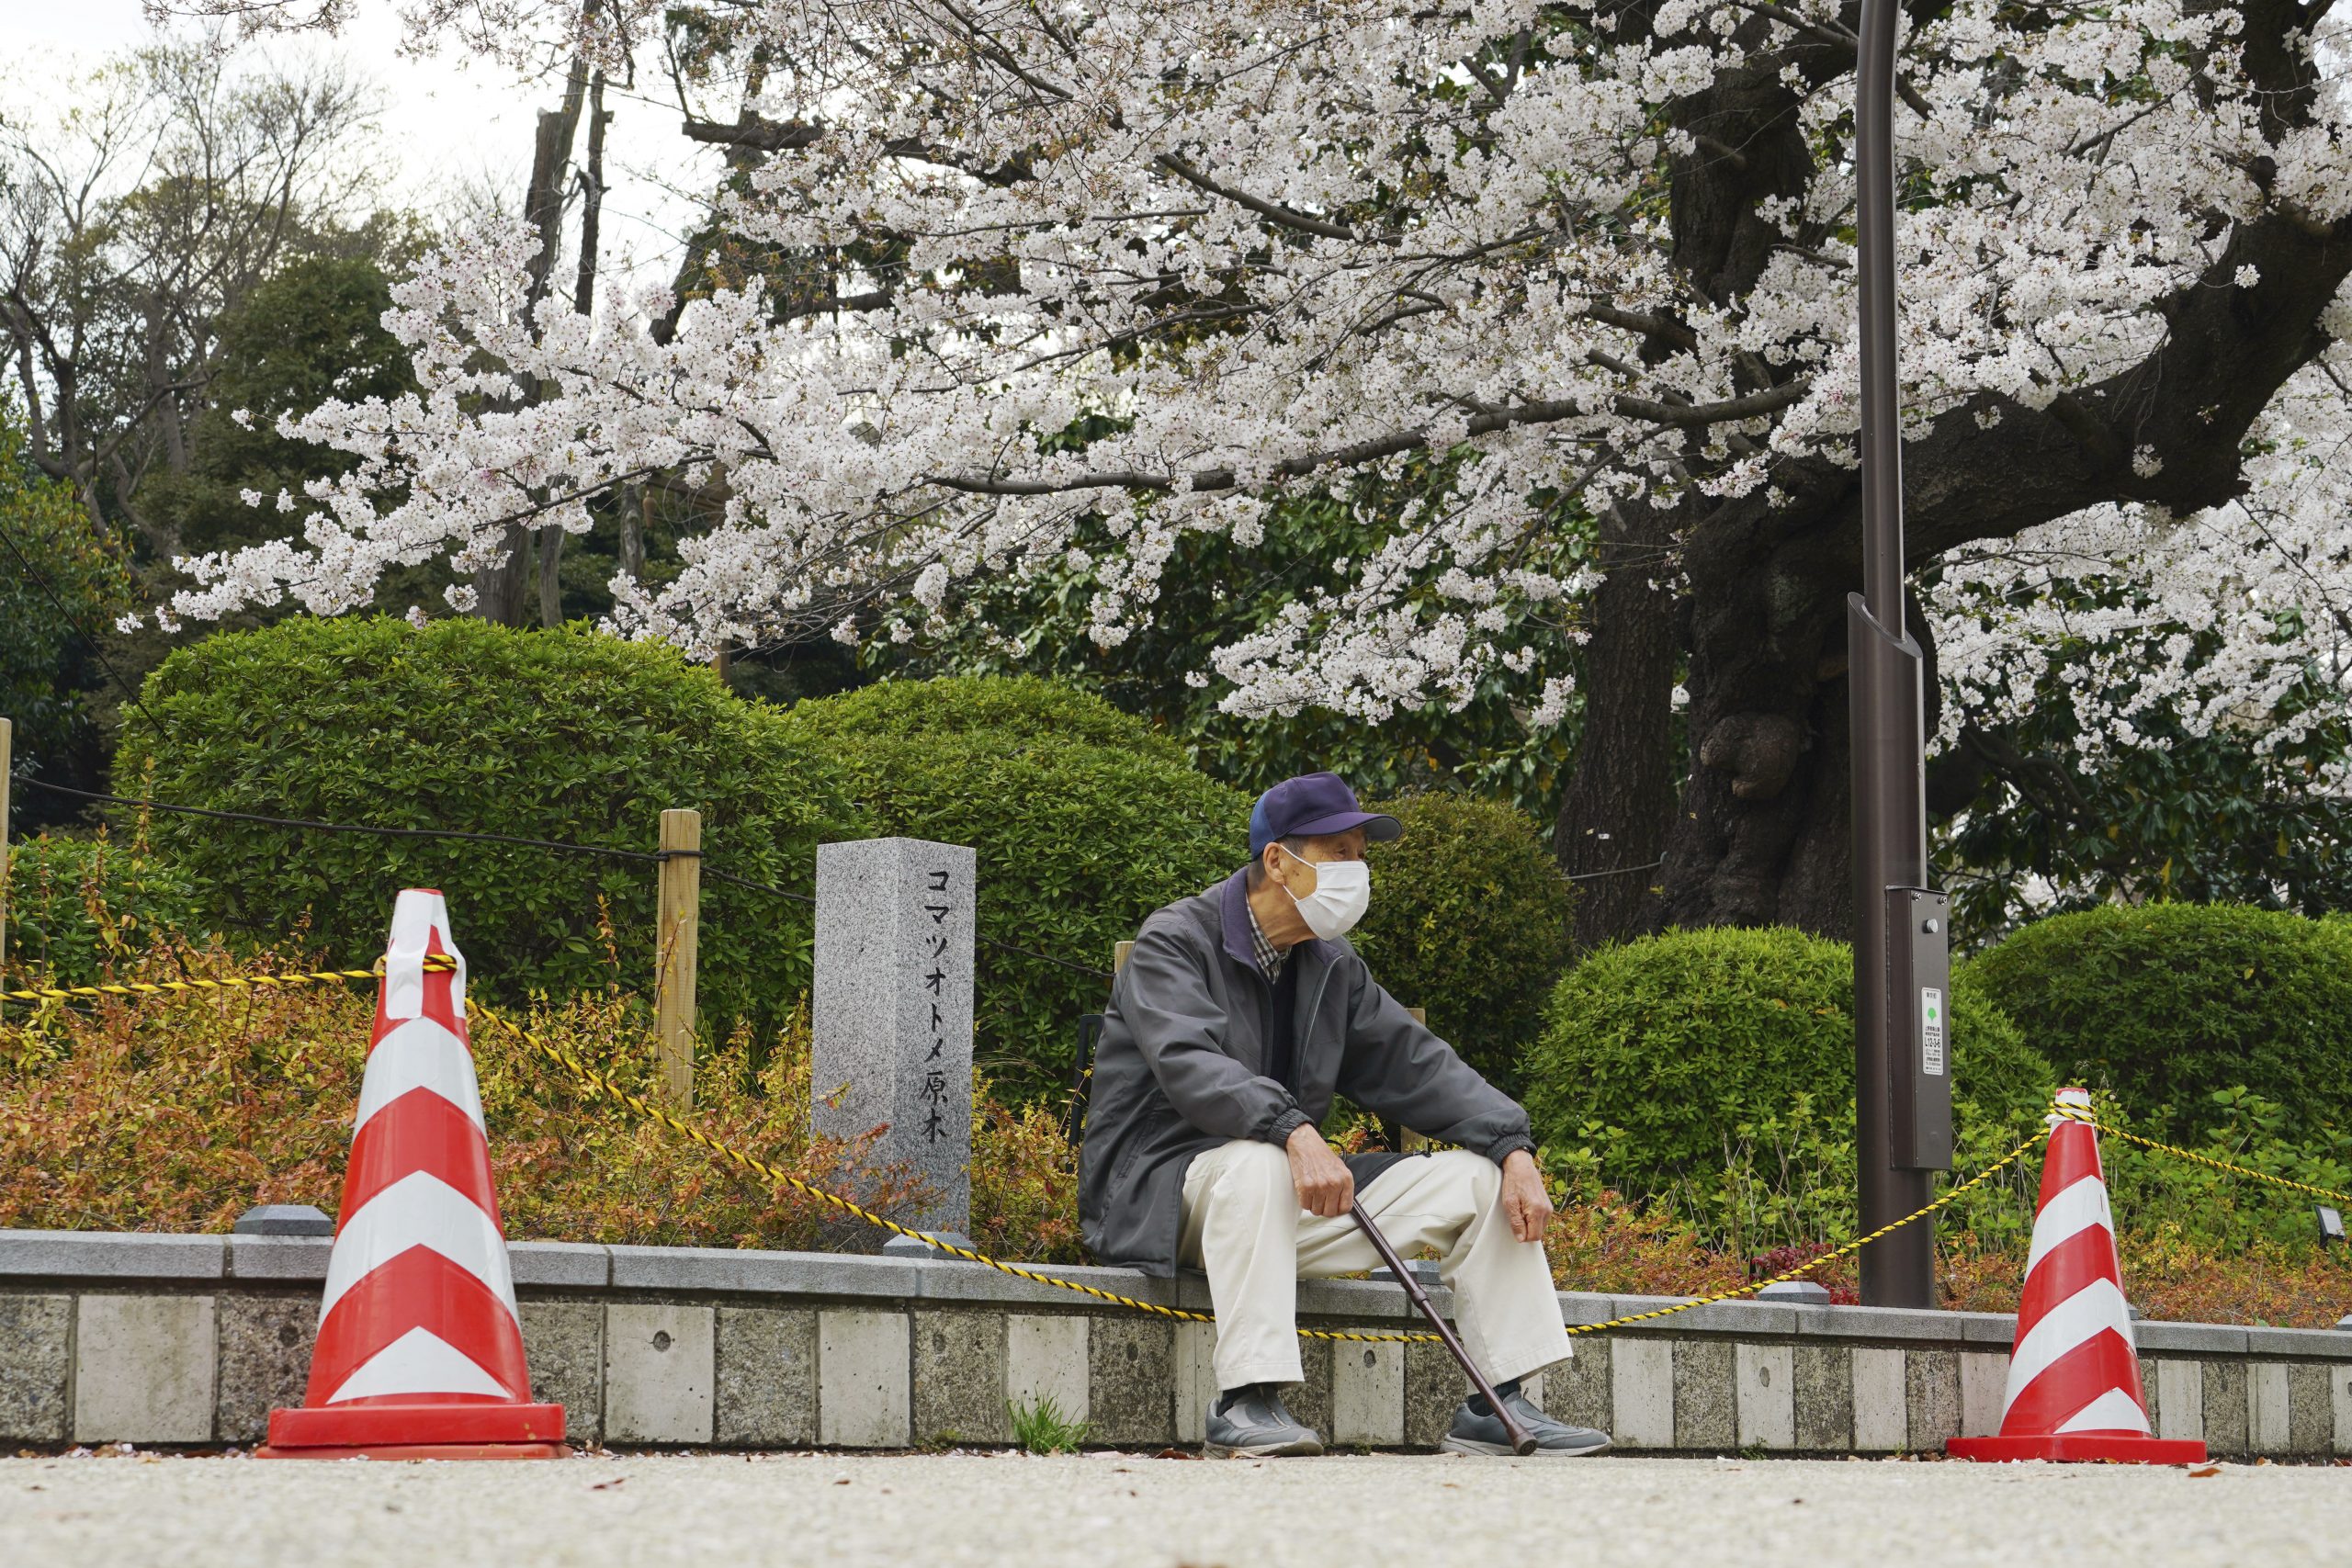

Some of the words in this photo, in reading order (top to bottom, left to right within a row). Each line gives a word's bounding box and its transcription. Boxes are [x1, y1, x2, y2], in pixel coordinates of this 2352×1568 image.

[920, 871, 949, 1145] コマツオトメ原木
